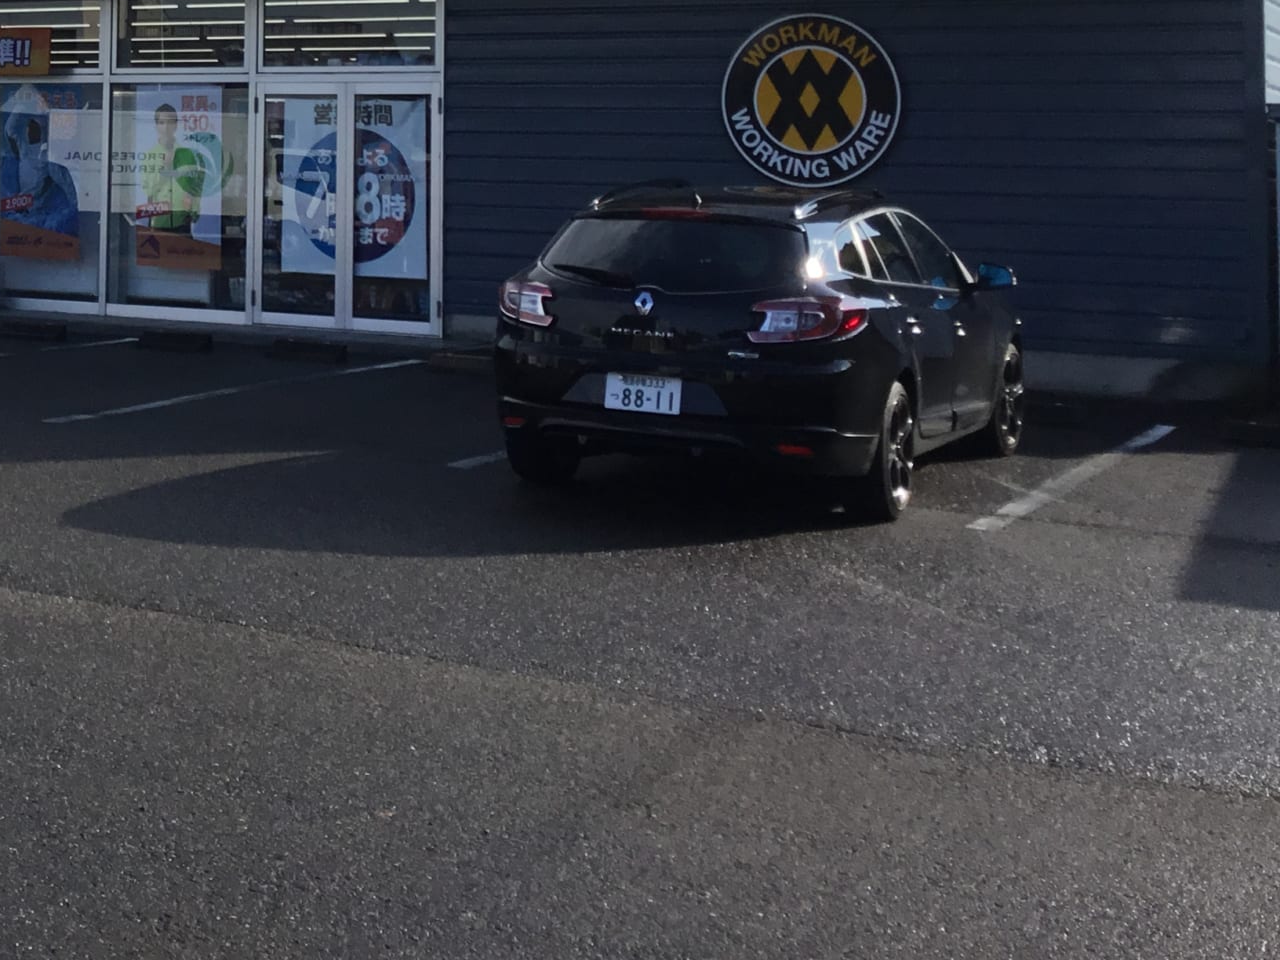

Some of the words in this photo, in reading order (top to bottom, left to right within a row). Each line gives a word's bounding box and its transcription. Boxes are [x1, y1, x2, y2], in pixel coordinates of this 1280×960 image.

[742, 23, 877, 68] WORKMAN
[314, 103, 393, 127] 営時間
[731, 107, 830, 179] WORKING
[833, 110, 892, 171] WARE
[357, 148, 389, 167] よる
[359, 227, 390, 245] まで
[621, 388, 674, 412] 88-11
